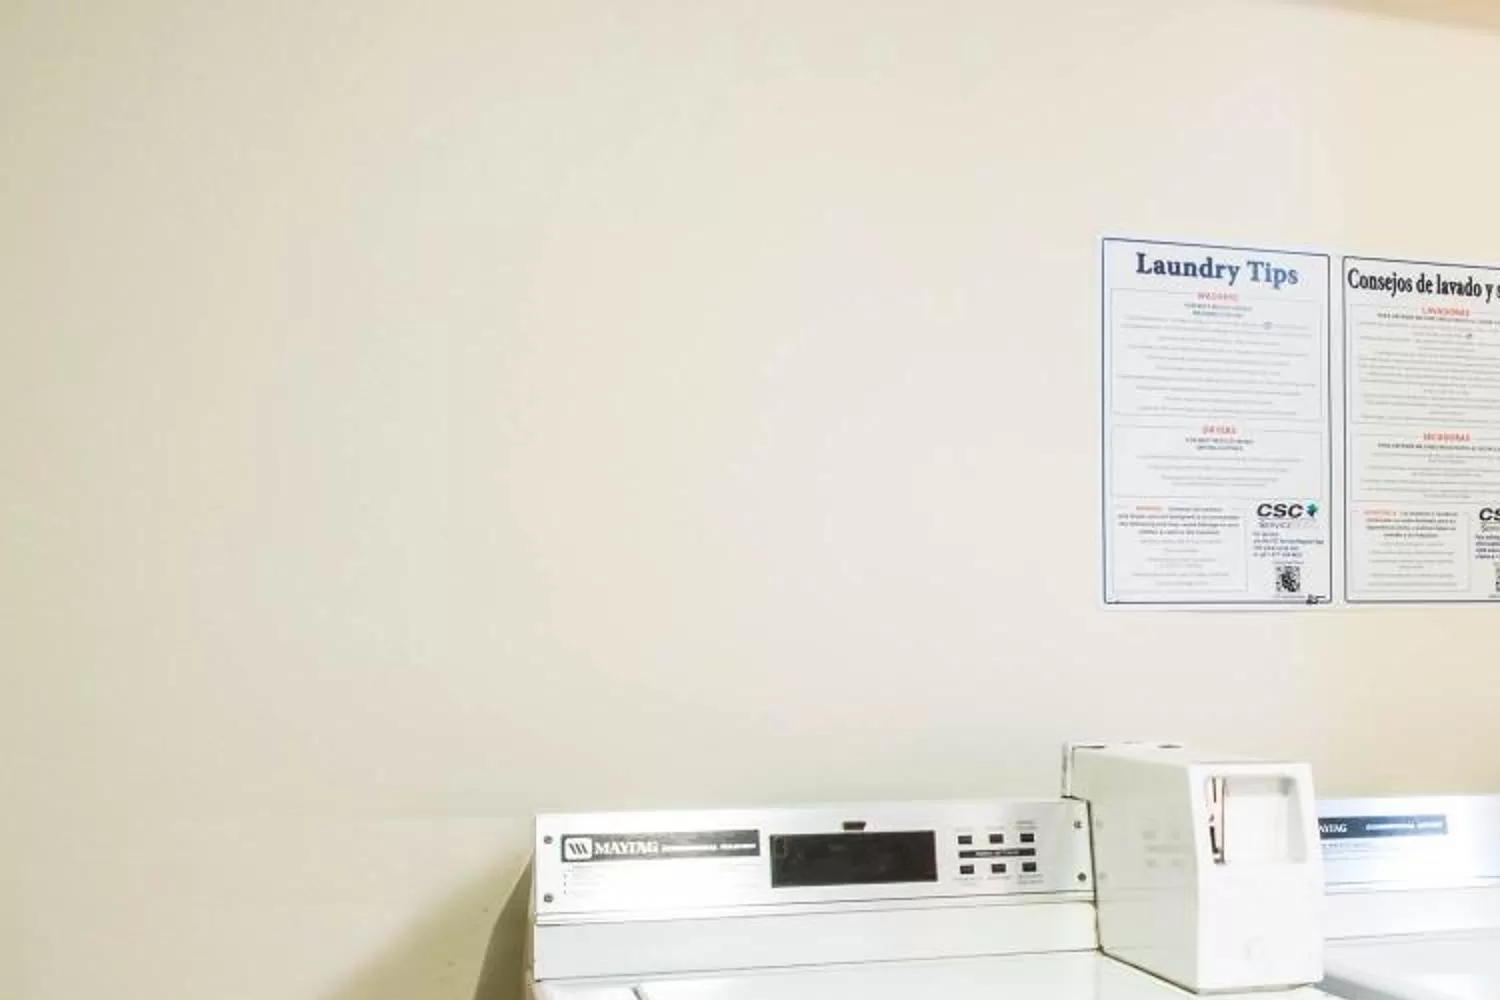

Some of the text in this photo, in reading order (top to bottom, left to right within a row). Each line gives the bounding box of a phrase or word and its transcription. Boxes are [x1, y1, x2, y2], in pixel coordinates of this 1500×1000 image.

[1135, 252, 1299, 289] Laundry Tips
[1347, 267, 1413, 298] Consejos
[1416, 272, 1433, 294] de
[1436, 273, 1482, 298] lavado
[1485, 283, 1495, 304] y
[1257, 503, 1303, 519] CSC
[1319, 823, 1348, 833] YTAG
[594, 840, 658, 855] MAYTAG
